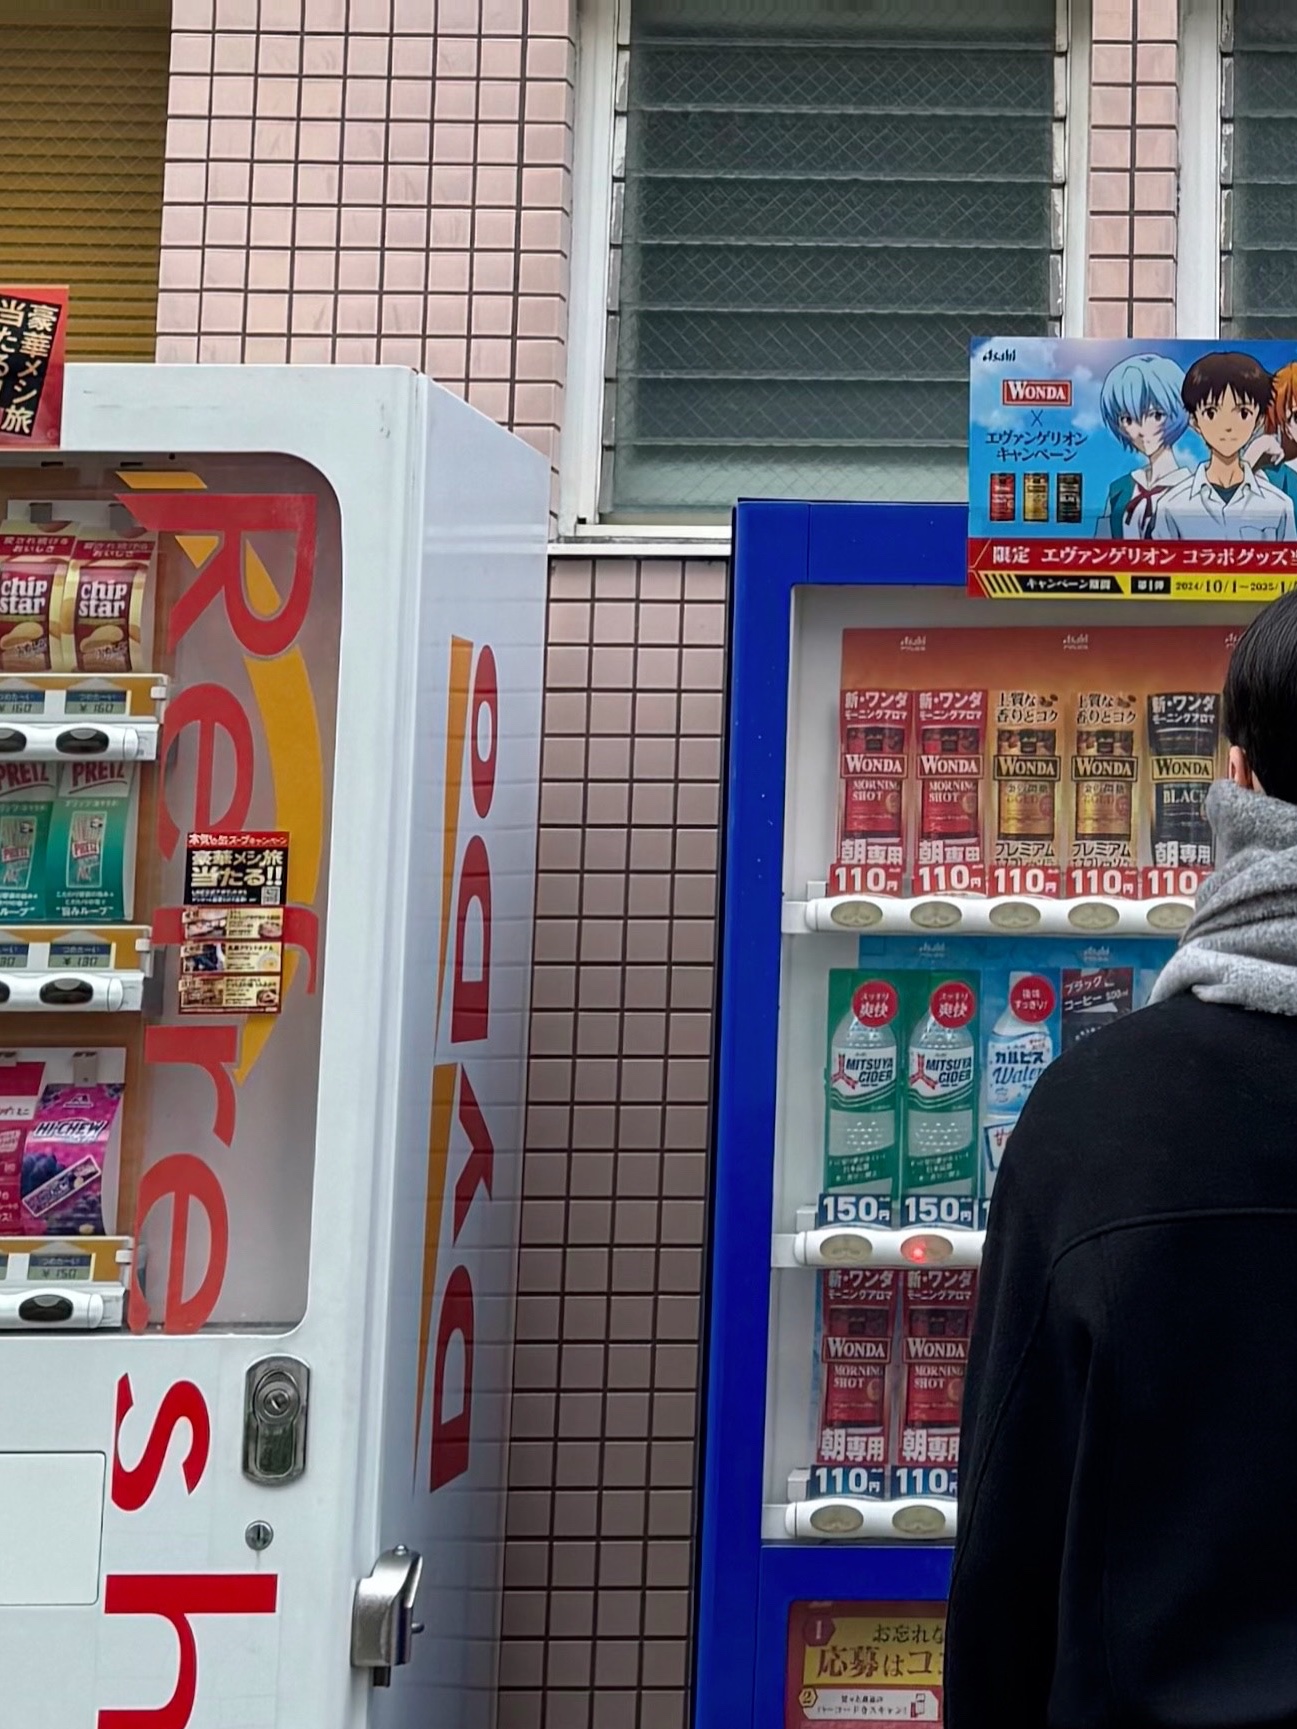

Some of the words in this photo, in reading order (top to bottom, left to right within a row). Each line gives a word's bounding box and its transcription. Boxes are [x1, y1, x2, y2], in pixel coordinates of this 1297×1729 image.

[983, 349, 1016, 362] Asahi
[1, 303, 59, 434] 豪華メシ旅
[1007, 381, 1067, 401] WONDA
[985, 431, 1088, 447] エヴァンゲリオン
[996, 449, 1078, 462] キャンペーン
[993, 545, 1030, 565] 限定
[1041, 547, 1176, 567] エヴァンゲリオン
[1, 576, 48, 596] chip
[80, 580, 128, 601] chip
[0, 595, 46, 615] star
[78, 599, 126, 618] star
[844, 691, 909, 709] 新・ワンダ
[919, 692, 983, 710] 新・ワンダ
[1152, 695, 1216, 713] 新・ワンダ
[997, 708, 1059, 723] 香りとコク
[1076, 709, 1137, 724] 香りとコク
[846, 755, 902, 773] WONDA
[921, 755, 978, 774] WONDA
[1000, 757, 1056, 777] WONDA
[1077, 757, 1132, 776] WONDA
[1155, 758, 1210, 776] WONDA
[852, 791, 882, 801] SHOT
[929, 791, 960, 803] SHOT
[191, 849, 284, 867] 豪華メシ旅
[995, 842, 1055, 858] プレミアム
[1072, 842, 1131, 858] プレミアム
[1155, 841, 1211, 867] 朝専用
[835, 867, 898, 891] 110円
[919, 865, 981, 892] 110円
[994, 867, 1057, 895] 110円
[1072, 868, 1134, 895] 110円
[1148, 869, 1198, 896] 110
[1064, 994, 1103, 1012] コーヒー
[845, 1057, 894, 1072] MITSUYA
[925, 1057, 972, 1071] MITSUYA
[995, 1051, 1045, 1066] カルピス
[429, 645, 498, 1493] DyDo
[858, 1070, 893, 1084] CIDER
[938, 1070, 972, 1084] CIDER
[823, 1196, 891, 1223] 150円
[904, 1196, 972, 1223] 150円
[828, 1270, 894, 1288] 新・ワンダ
[907, 1270, 973, 1288] 新・ワンダ
[827, 1337, 885, 1358] WONDA
[907, 1338, 965, 1358] WONDA
[834, 1366, 883, 1377] MORNING
[914, 1366, 963, 1377] MORNING
[834, 1377, 865, 1389] SHOT
[914, 1377, 945, 1389] SHOT
[821, 1428, 885, 1462] 朝専用
[815, 1467, 881, 1495] 110円
[872, 1624, 944, 1644] お忘れな
[816, 1645, 943, 1678] 応募はコ
[803, 1691, 812, 1705] 2
